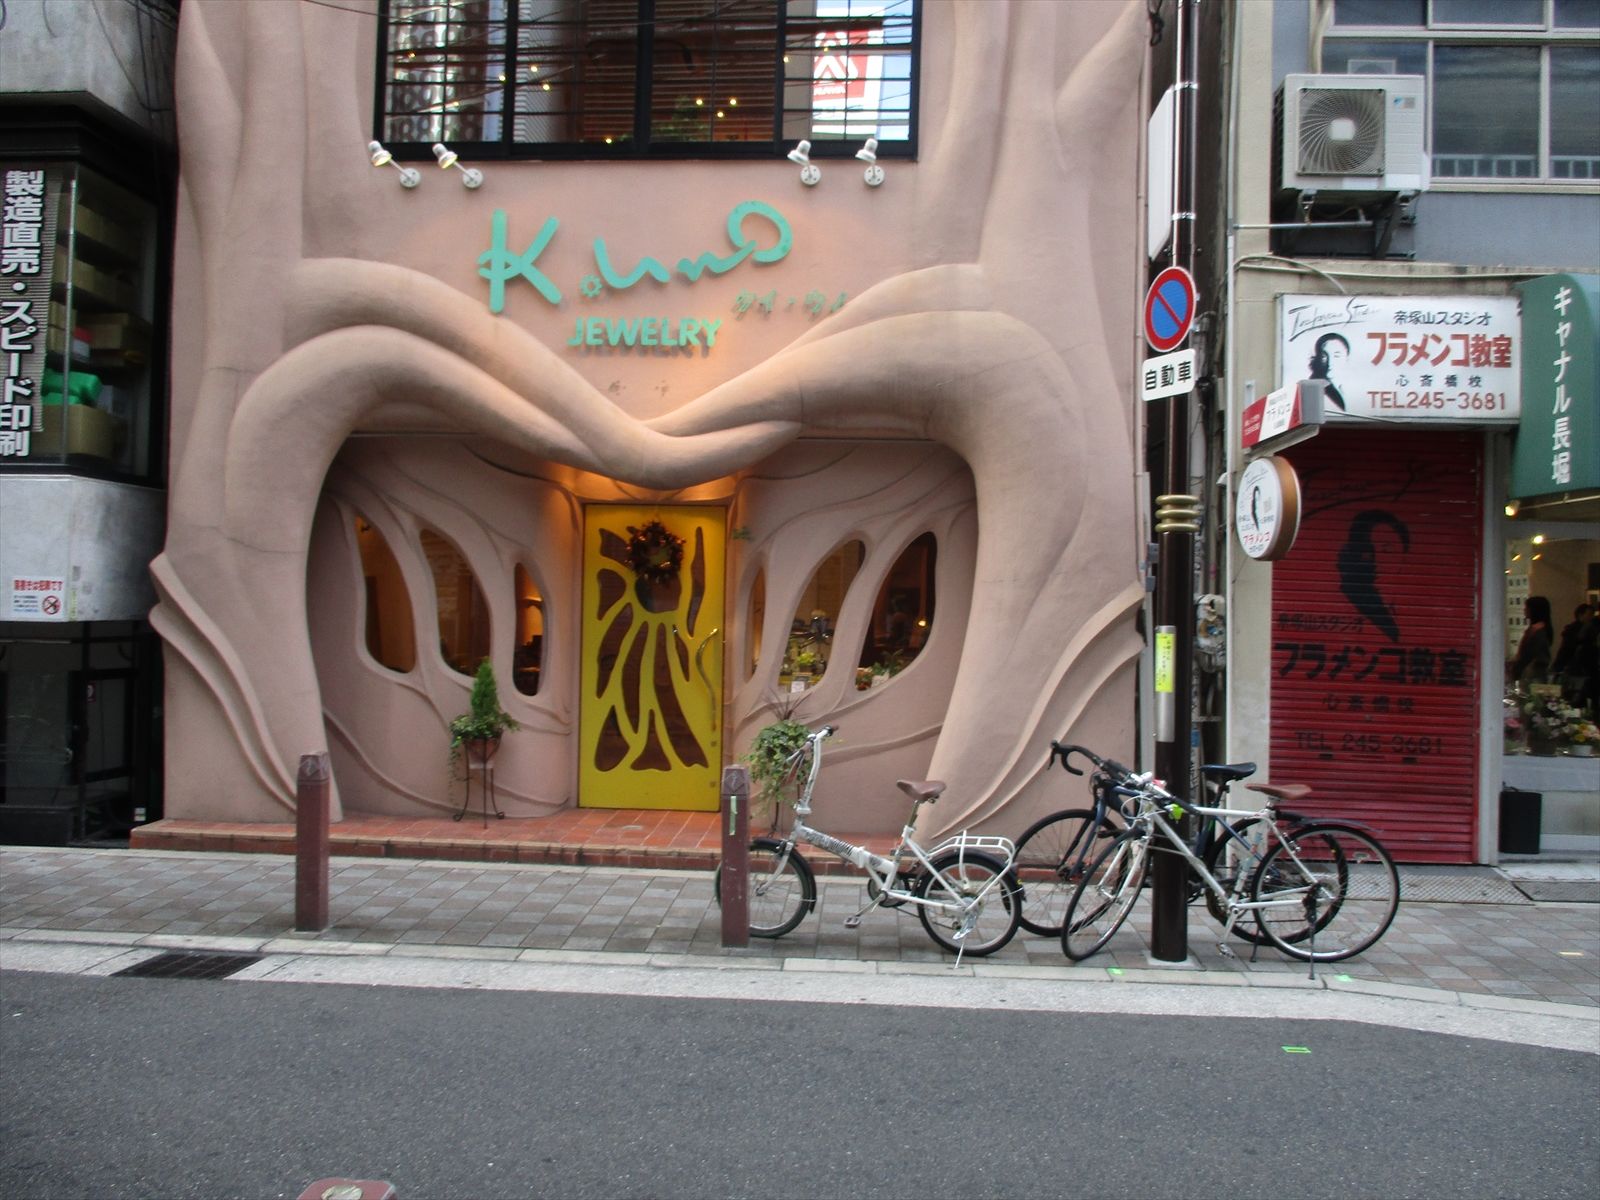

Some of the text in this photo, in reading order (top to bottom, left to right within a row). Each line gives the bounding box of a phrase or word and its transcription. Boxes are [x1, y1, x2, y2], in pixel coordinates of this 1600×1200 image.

[567, 316, 723, 347] JEWELRY
[1393, 310, 1492, 326] 帝塚山スタジオ
[1366, 332, 1512, 368] フラメンコ教室
[1145, 360, 1192, 391] 自動車
[1551, 286, 1573, 485] キャナル長堀
[1275, 643, 1468, 685] フラメンコ教室
[1294, 731, 1333, 751] TEL
[1341, 733, 1382, 753] 245
